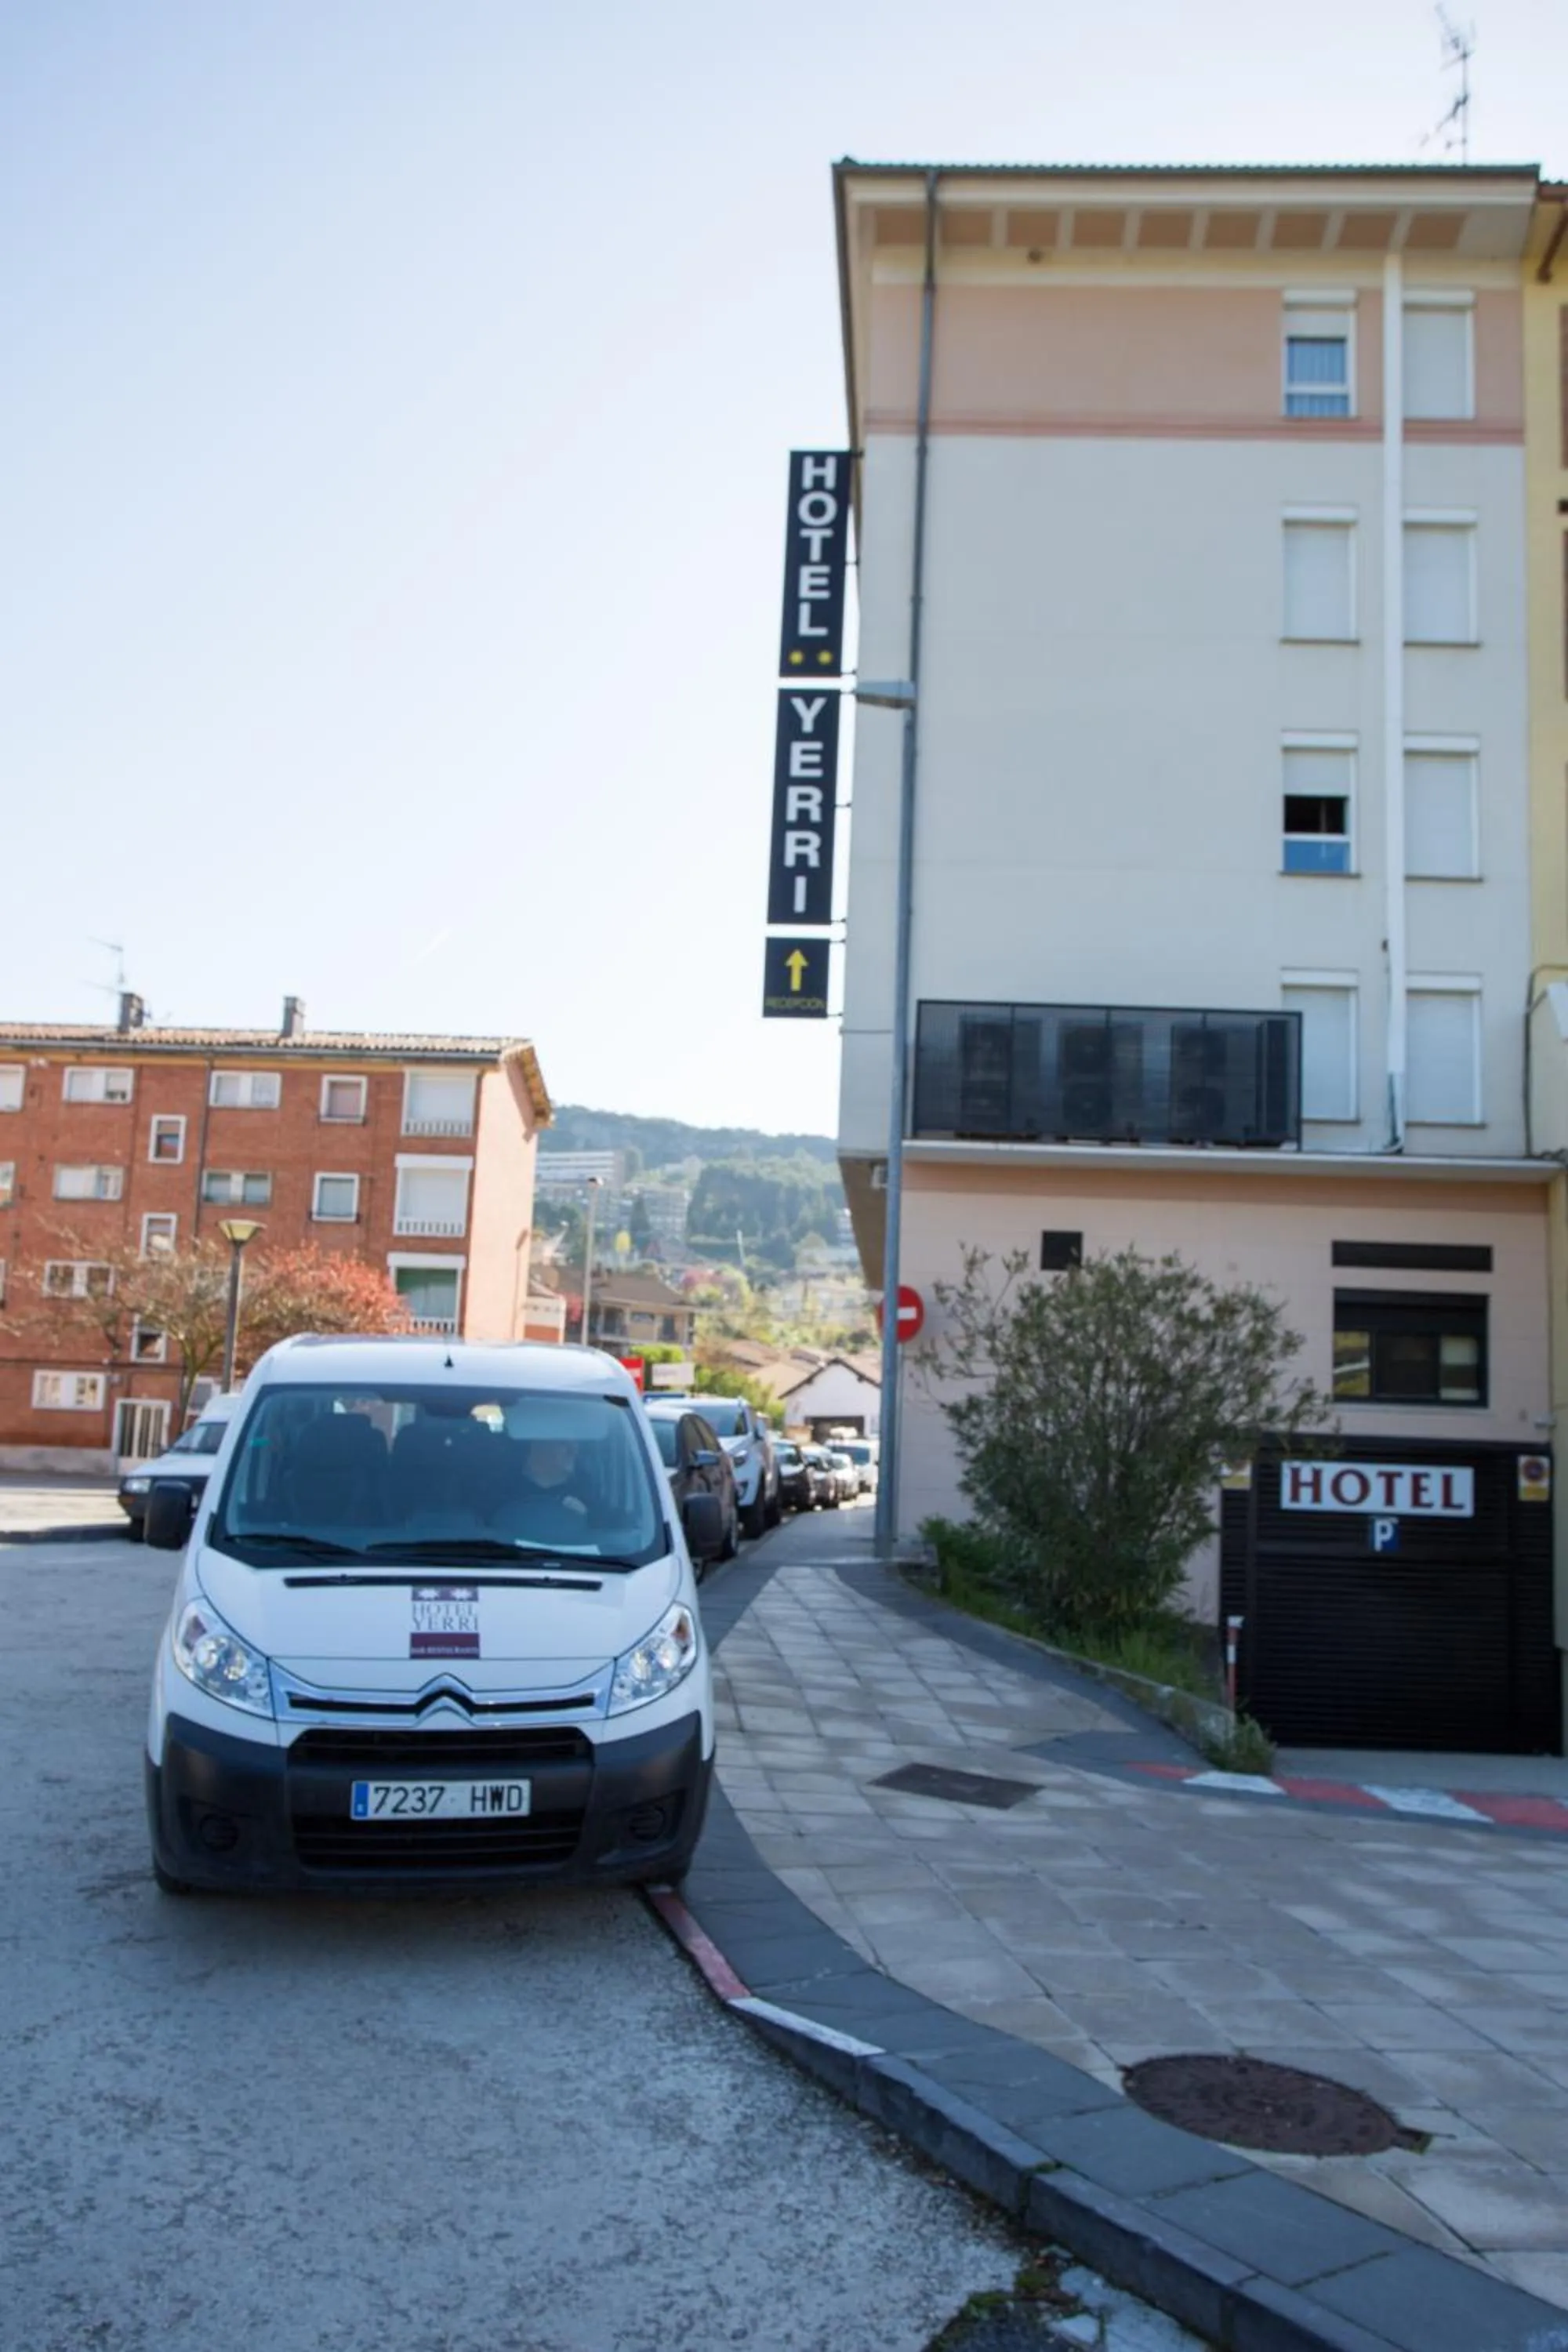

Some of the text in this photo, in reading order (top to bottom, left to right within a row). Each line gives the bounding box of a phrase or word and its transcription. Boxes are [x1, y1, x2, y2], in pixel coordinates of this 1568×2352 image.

[797, 456, 838, 637] HOTEL
[784, 697, 827, 914] YERRI
[1289, 1465, 1465, 1510] HOTEL
[1374, 1519, 1393, 1552] P
[412, 1603, 474, 1616] HOTEL
[412, 1617, 479, 1631] YERRI
[373, 1784, 523, 1815] 7237 HWD
